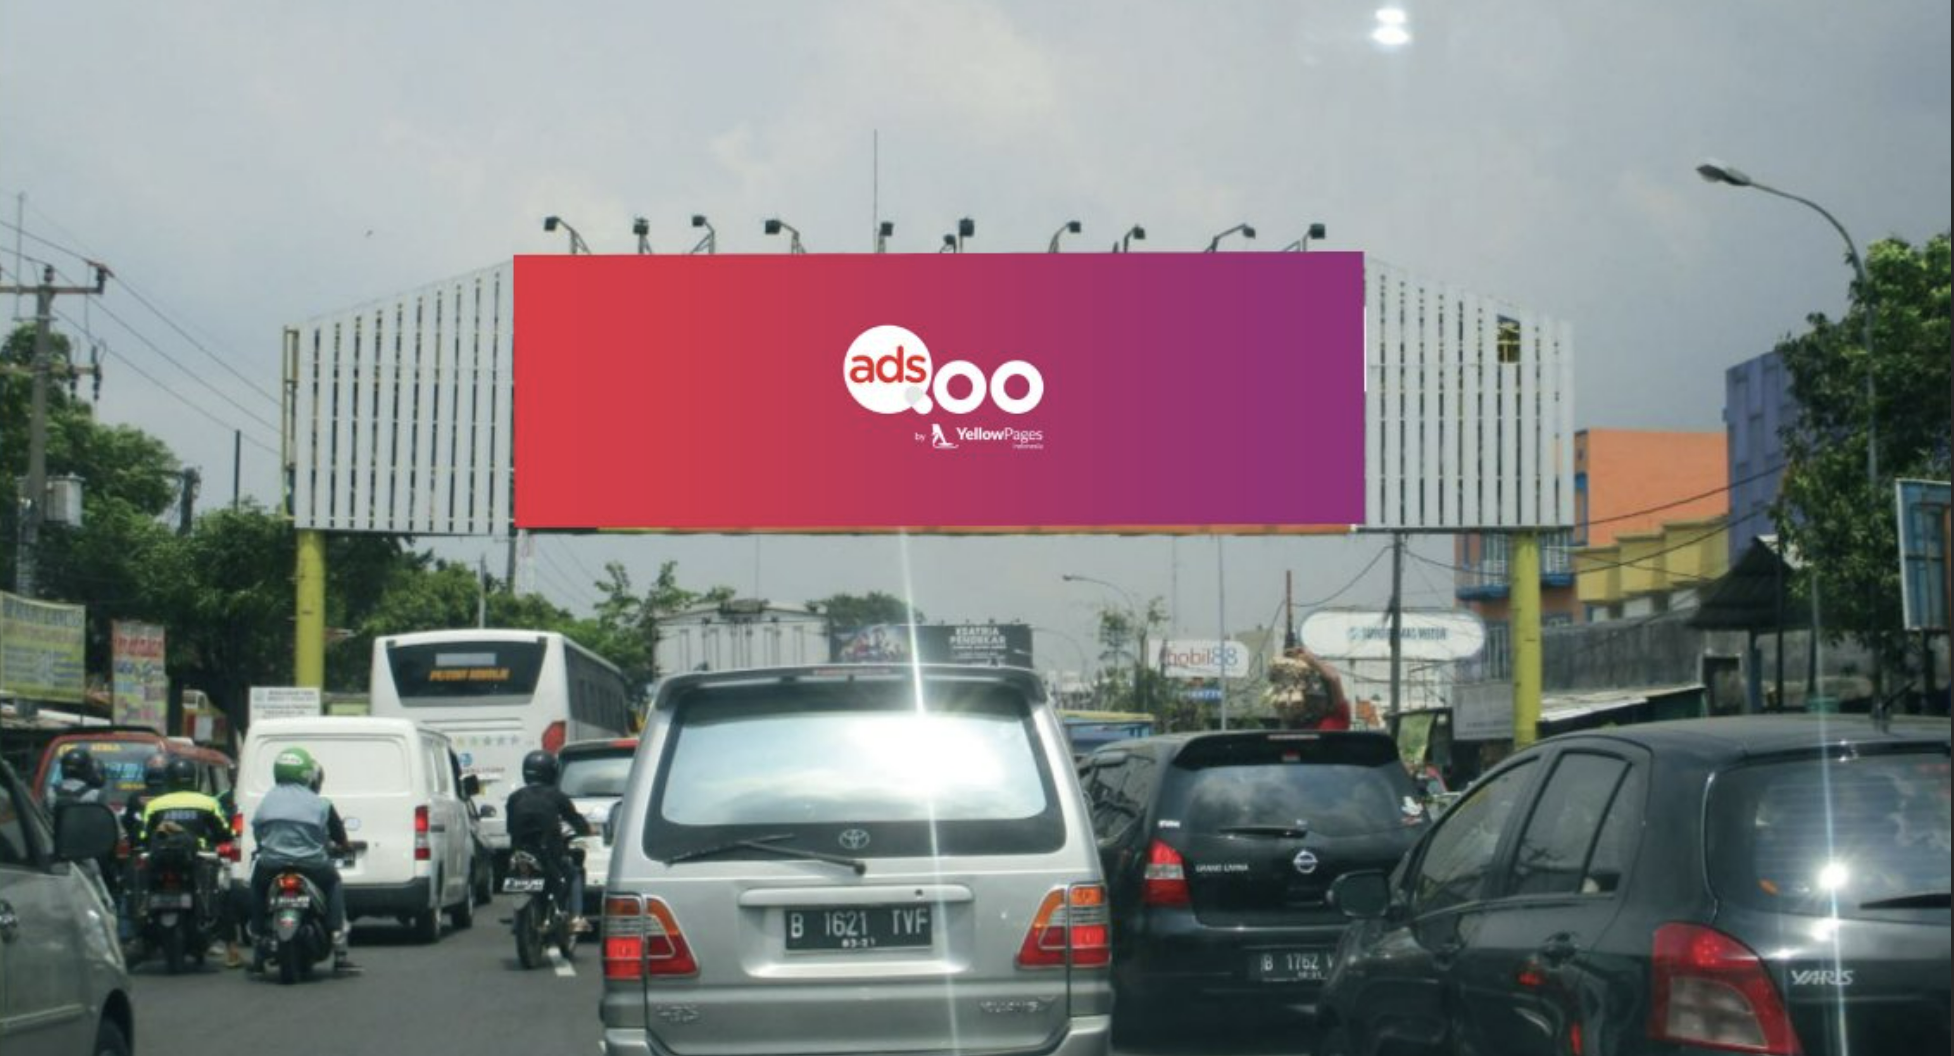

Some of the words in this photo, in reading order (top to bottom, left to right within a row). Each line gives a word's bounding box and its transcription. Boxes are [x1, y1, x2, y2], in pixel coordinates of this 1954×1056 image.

[914, 432, 926, 443] by
[956, 426, 1044, 444] YellowPages
[790, 912, 804, 938] B
[824, 910, 868, 937] 1621
[892, 907, 928, 935] TVF
[1262, 953, 1273, 971] B
[1790, 969, 1854, 986] YARIS
